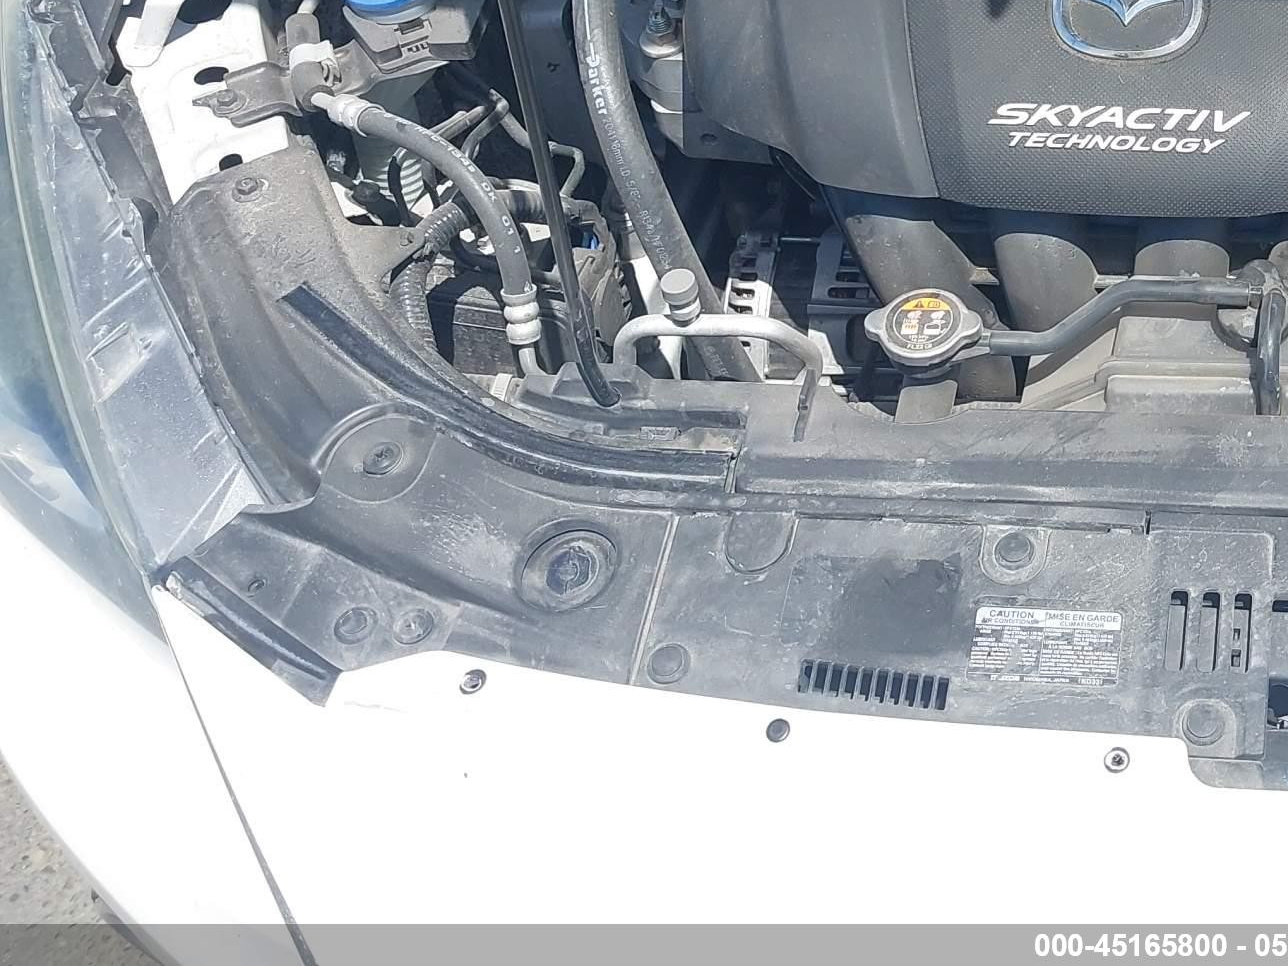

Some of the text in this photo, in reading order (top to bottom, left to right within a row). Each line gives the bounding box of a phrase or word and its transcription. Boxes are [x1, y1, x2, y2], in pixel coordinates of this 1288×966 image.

[585, 54, 608, 115] Parker
[987, 103, 1252, 133] SKYACTIV
[1007, 131, 1226, 154] TECHNOLOGY
[989, 610, 1035, 619] CAUTION
[1086, 615, 1119, 623] GARDE
